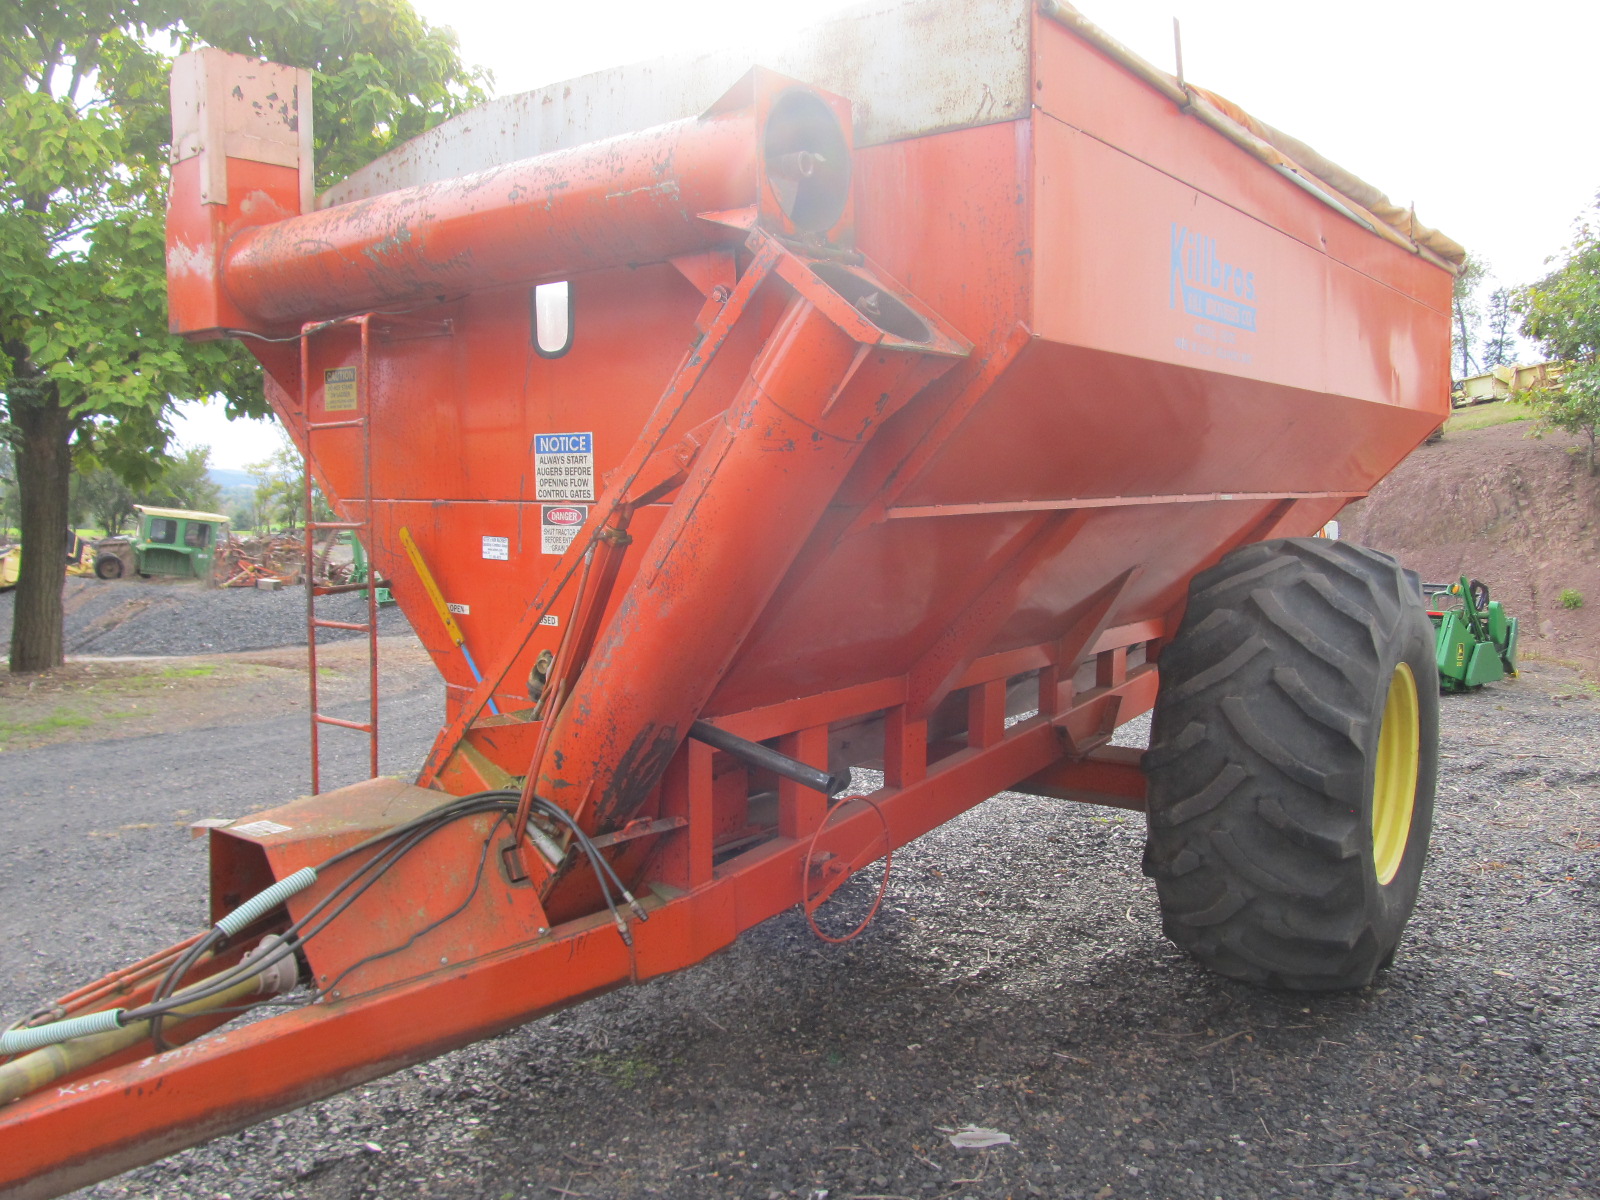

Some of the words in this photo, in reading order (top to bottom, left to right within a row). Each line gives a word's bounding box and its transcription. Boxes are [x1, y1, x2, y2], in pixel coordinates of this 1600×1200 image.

[1170, 222, 1255, 310] Killbros
[326, 369, 354, 382] CAUTION
[540, 435, 586, 452] NOTICE
[539, 455, 565, 465] ALWAYS
[566, 455, 588, 464] START
[536, 467, 563, 476] AUGERS
[564, 466, 592, 476] BEFORE
[539, 478, 569, 487] OPENING
[569, 478, 589, 487] FLOW
[537, 489, 569, 498] CONTROL
[569, 489, 591, 498] GATES
[551, 511, 578, 521] DANGER
[543, 528, 555, 536] SHUT
[555, 528, 575, 536] TRACTOR
[544, 536, 562, 544] BEFORE
[449, 604, 465, 613] OPEN
[540, 616, 556, 625] OSED
